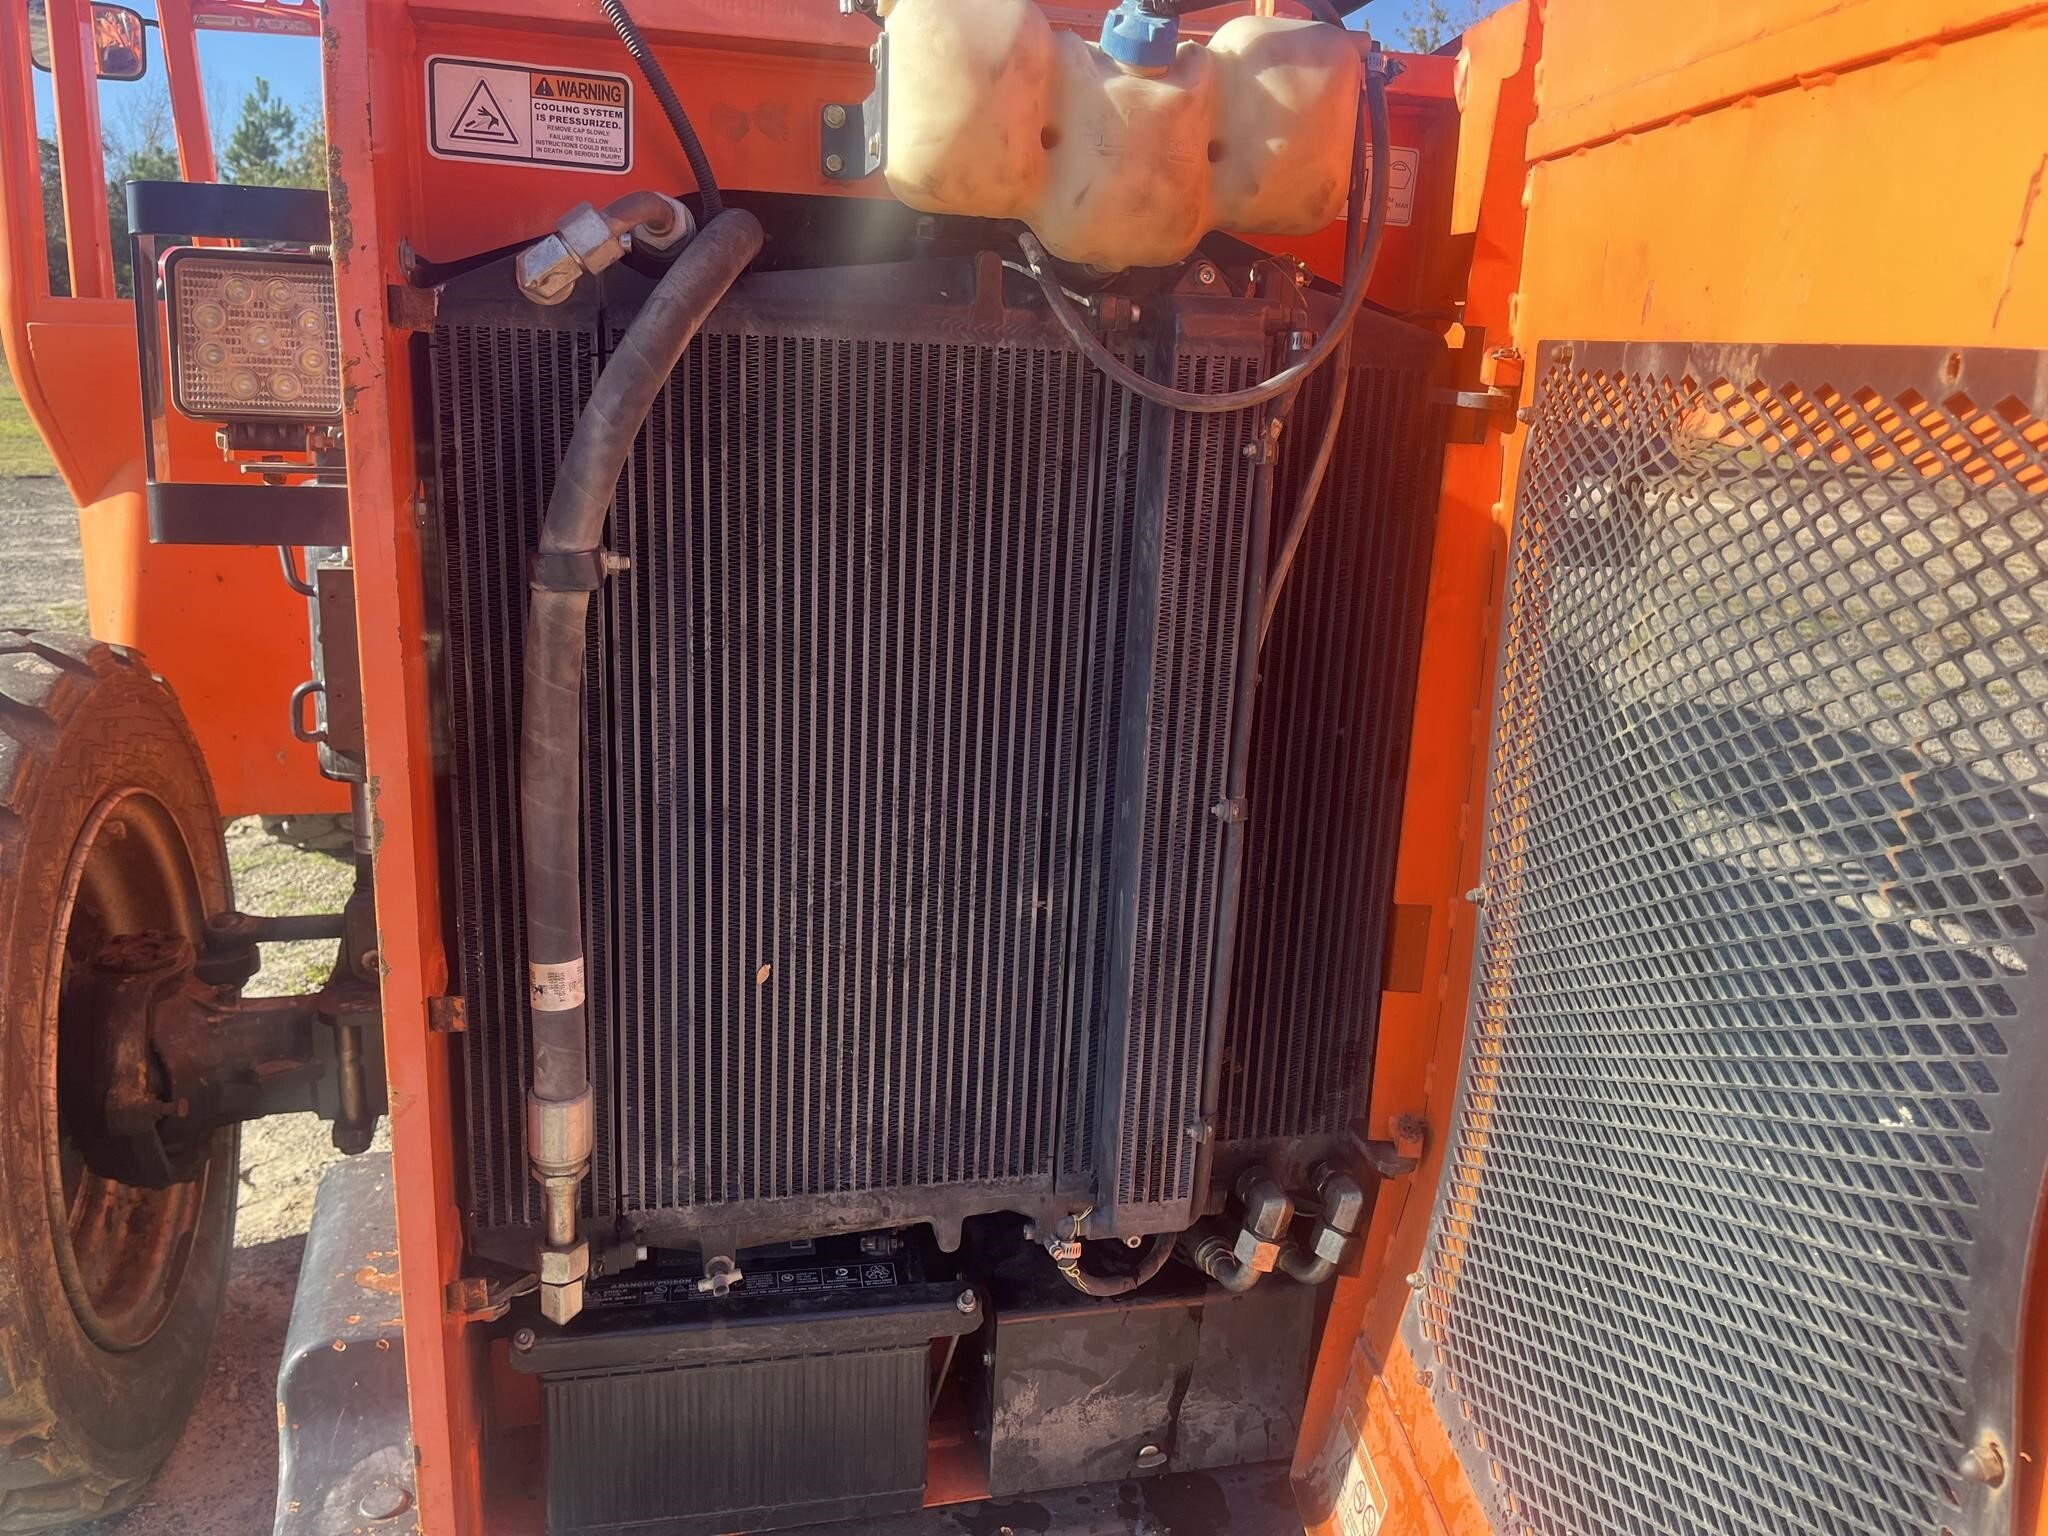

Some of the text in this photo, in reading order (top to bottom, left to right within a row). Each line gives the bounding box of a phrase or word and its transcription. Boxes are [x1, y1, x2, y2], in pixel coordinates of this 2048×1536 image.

[557, 80, 621, 102] WARNING
[534, 103, 623, 118] COOLING SYSTEM
[549, 115, 621, 129] PRESSURIZED.
[536, 140, 579, 149] INSTRUCTIONS
[579, 143, 599, 151] COULD
[574, 150, 599, 158] SERIOUS
